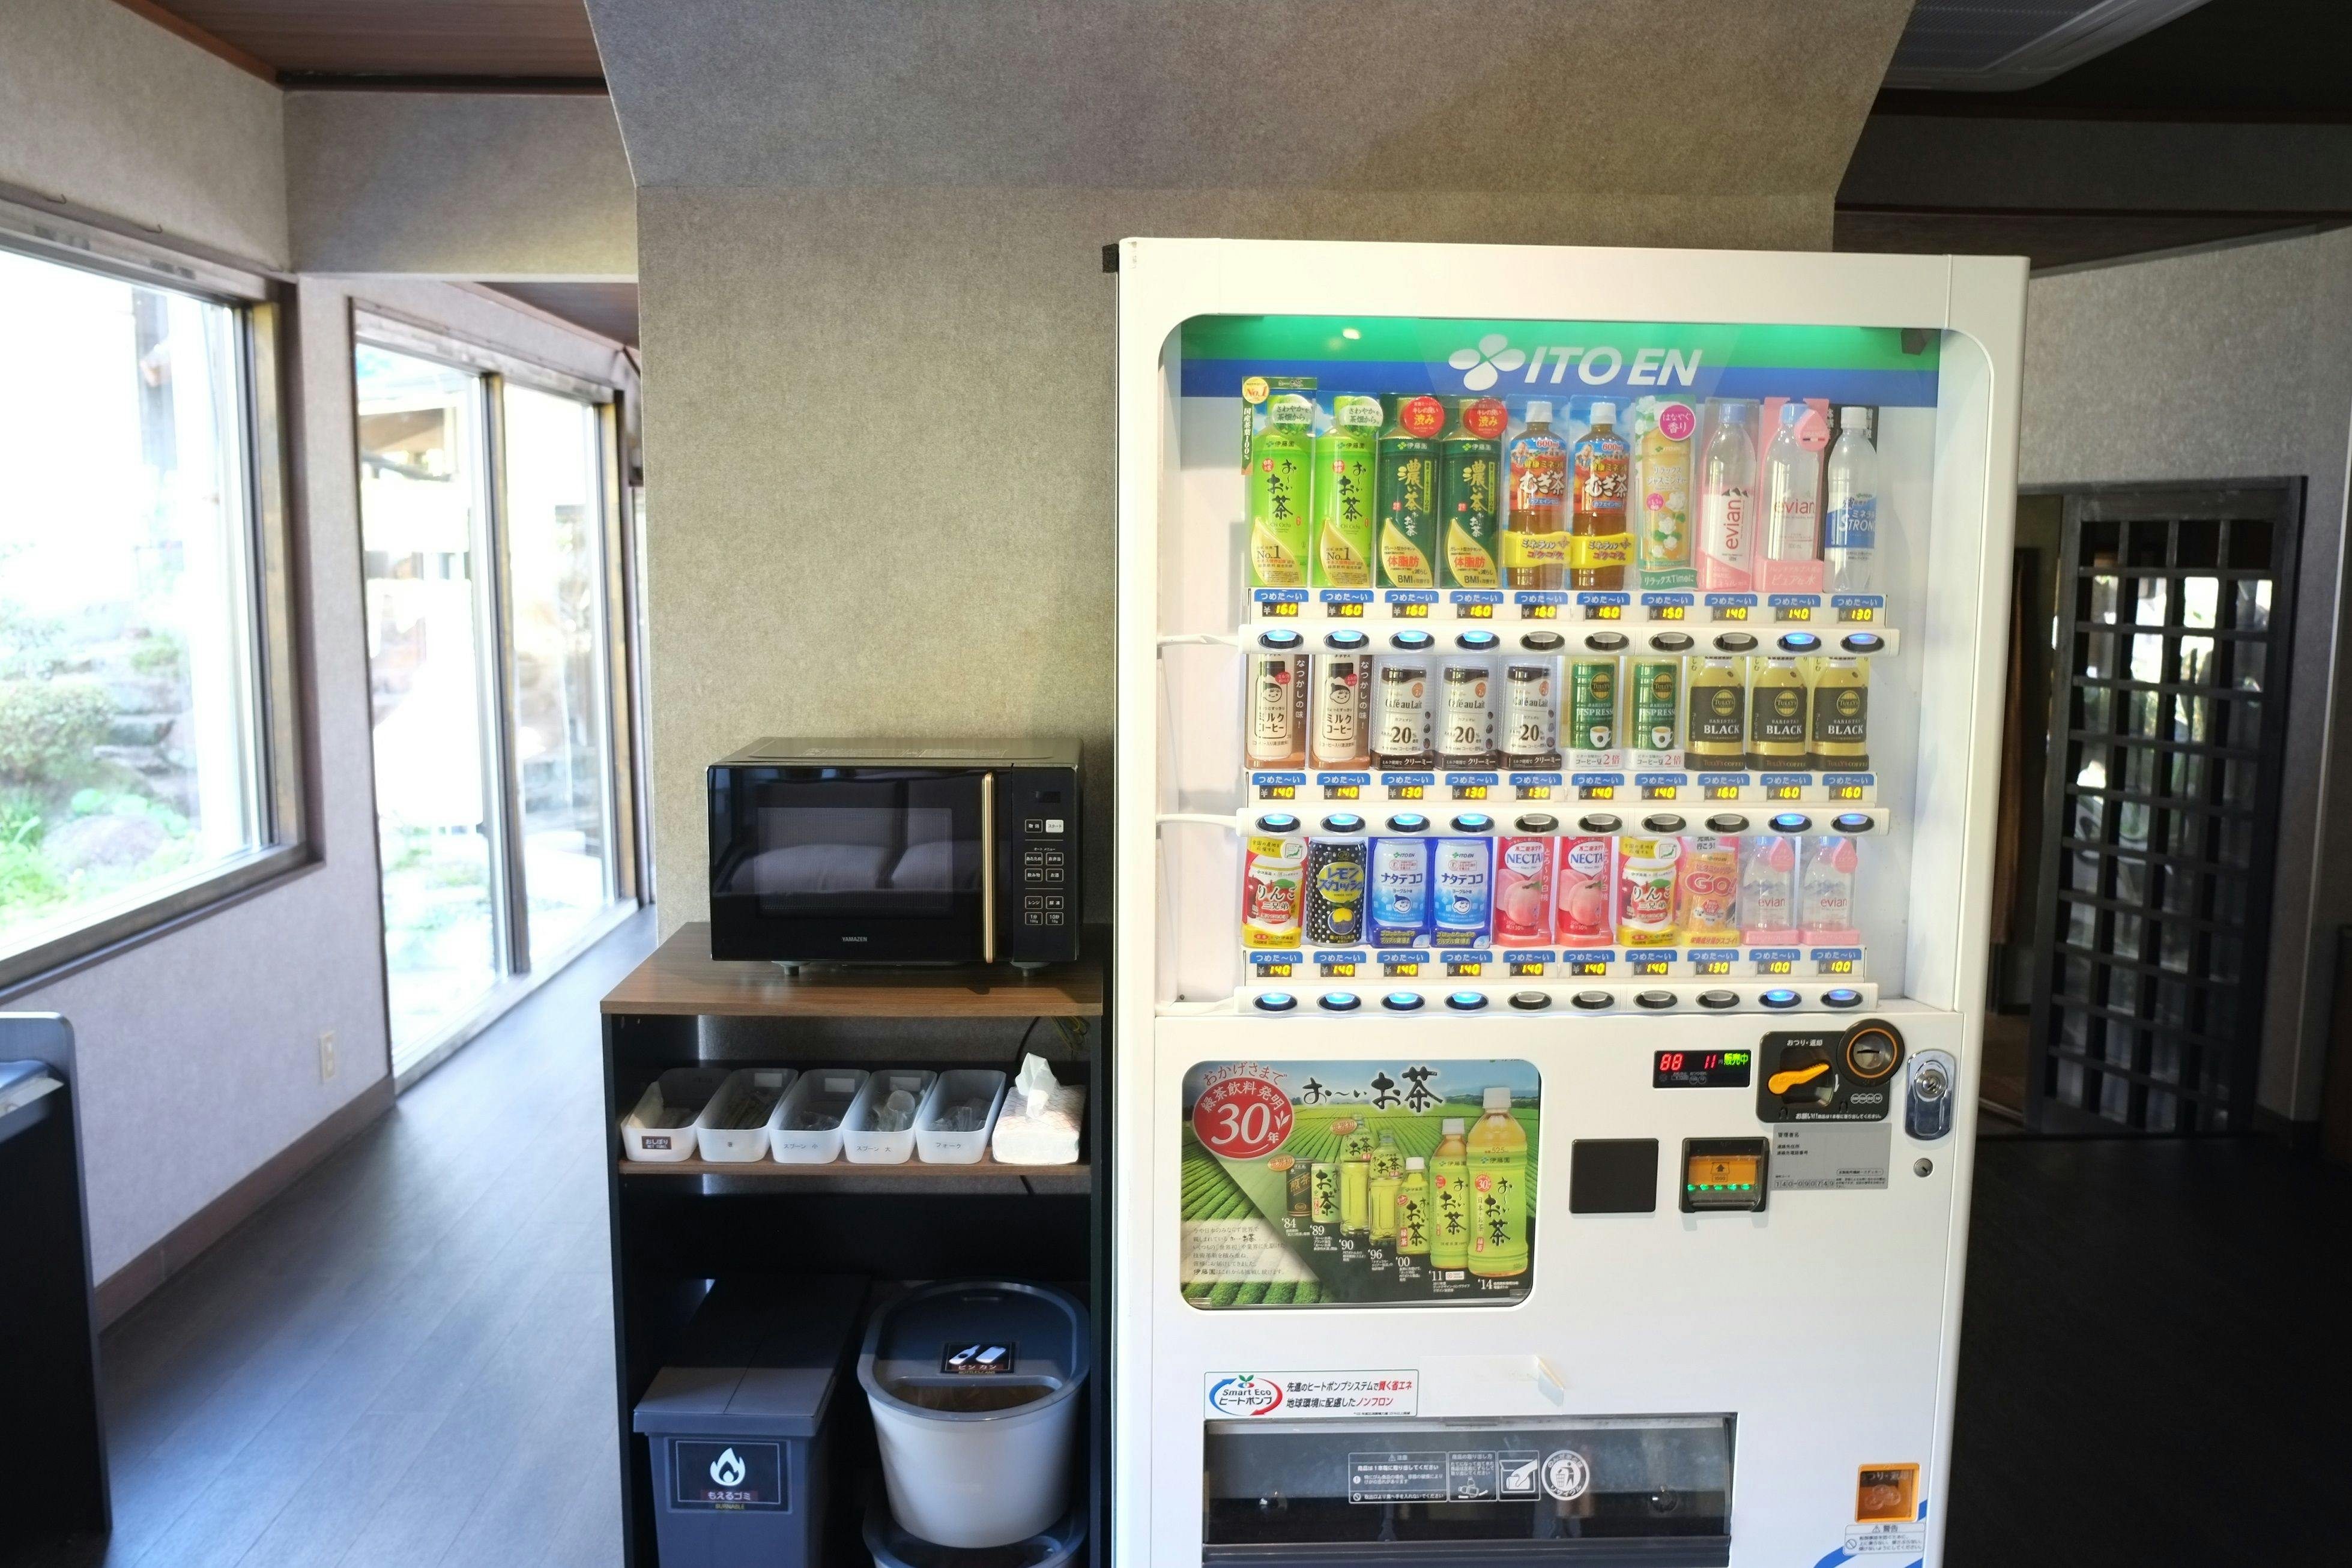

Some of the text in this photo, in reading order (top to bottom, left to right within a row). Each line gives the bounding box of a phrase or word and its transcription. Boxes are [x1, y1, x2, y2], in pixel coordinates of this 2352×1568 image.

[1524, 346, 1702, 387] ITO EN
[1414, 414, 1434, 426] 渋み
[1478, 416, 1498, 427] 渋み
[1667, 423, 1687, 434] 香り
[1519, 470, 1565, 495] むぎ茶
[1585, 473, 1628, 498] むぎ茶
[1726, 499, 1742, 549] evian
[1257, 545, 1281, 559] No.1
[1327, 547, 1350, 561] No.1
[1387, 556, 1419, 568] 体脂肪
[1454, 556, 1486, 568] 体脂肪
[1411, 699, 1422, 709] Lait
[1474, 699, 1485, 709] Lait
[1327, 713, 1352, 724] ミルク
[1327, 725, 1352, 734] コーヒー
[1704, 725, 1740, 735] BLACK
[1766, 725, 1802, 735] BLACK
[1828, 725, 1864, 735] BLACK
[1570, 853, 1604, 864] NECTA
[1328, 867, 1359, 879] レモン
[1381, 872, 1423, 885] ナタデココ
[1441, 872, 1483, 885] ナタデココ
[1685, 872, 1737, 896] GO!
[1257, 885, 1297, 900] りんご
[1263, 902, 1289, 910] 三兄弟
[1758, 897, 1785, 908] evian
[1821, 897, 1847, 908] evian
[1724, 1052, 1749, 1066] 販売中
[1203, 1061, 1287, 1086] おかげさまで
[1201, 1081, 1285, 1113] 緑茶飲料 発明
[1220, 1396, 1273, 1406] ヒートポンプ
[707, 1491, 751, 1501] もえるゴミ
